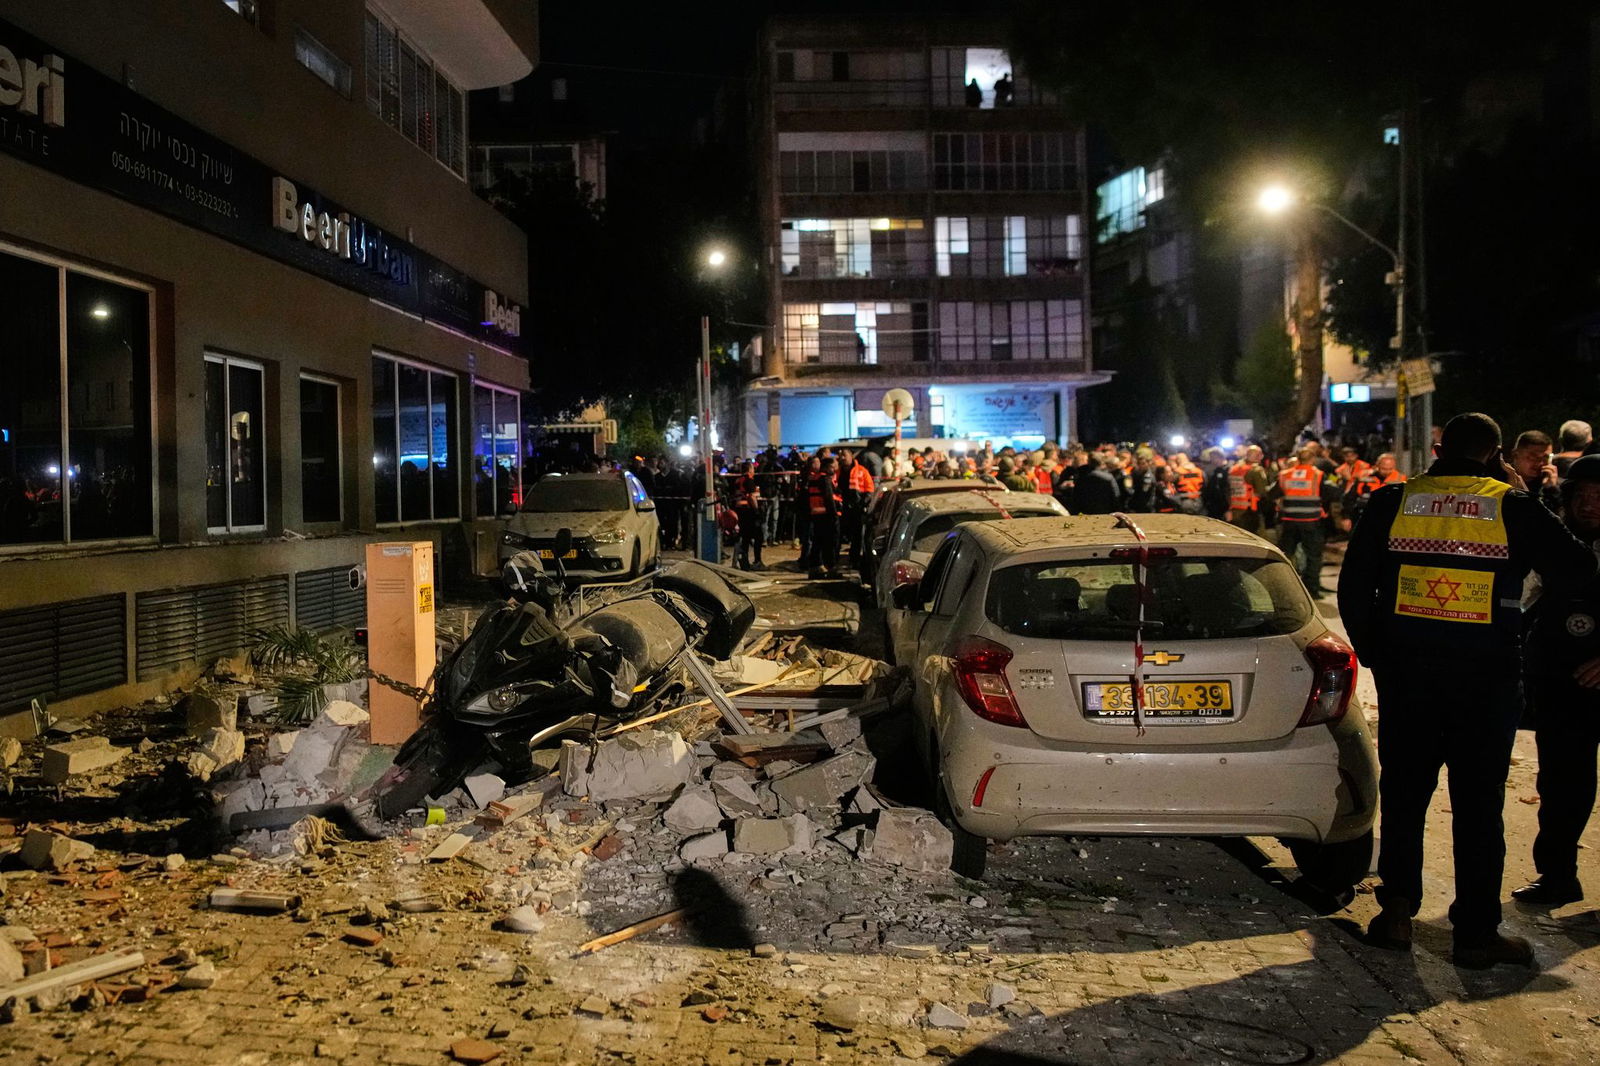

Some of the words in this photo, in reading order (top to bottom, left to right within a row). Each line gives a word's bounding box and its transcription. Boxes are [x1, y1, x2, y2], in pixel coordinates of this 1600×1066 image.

[120, 111, 161, 152] יוקרה
[168, 135, 196, 168] נכסי
[201, 152, 233, 185] שיווק
[272, 176, 351, 260] Beeri
